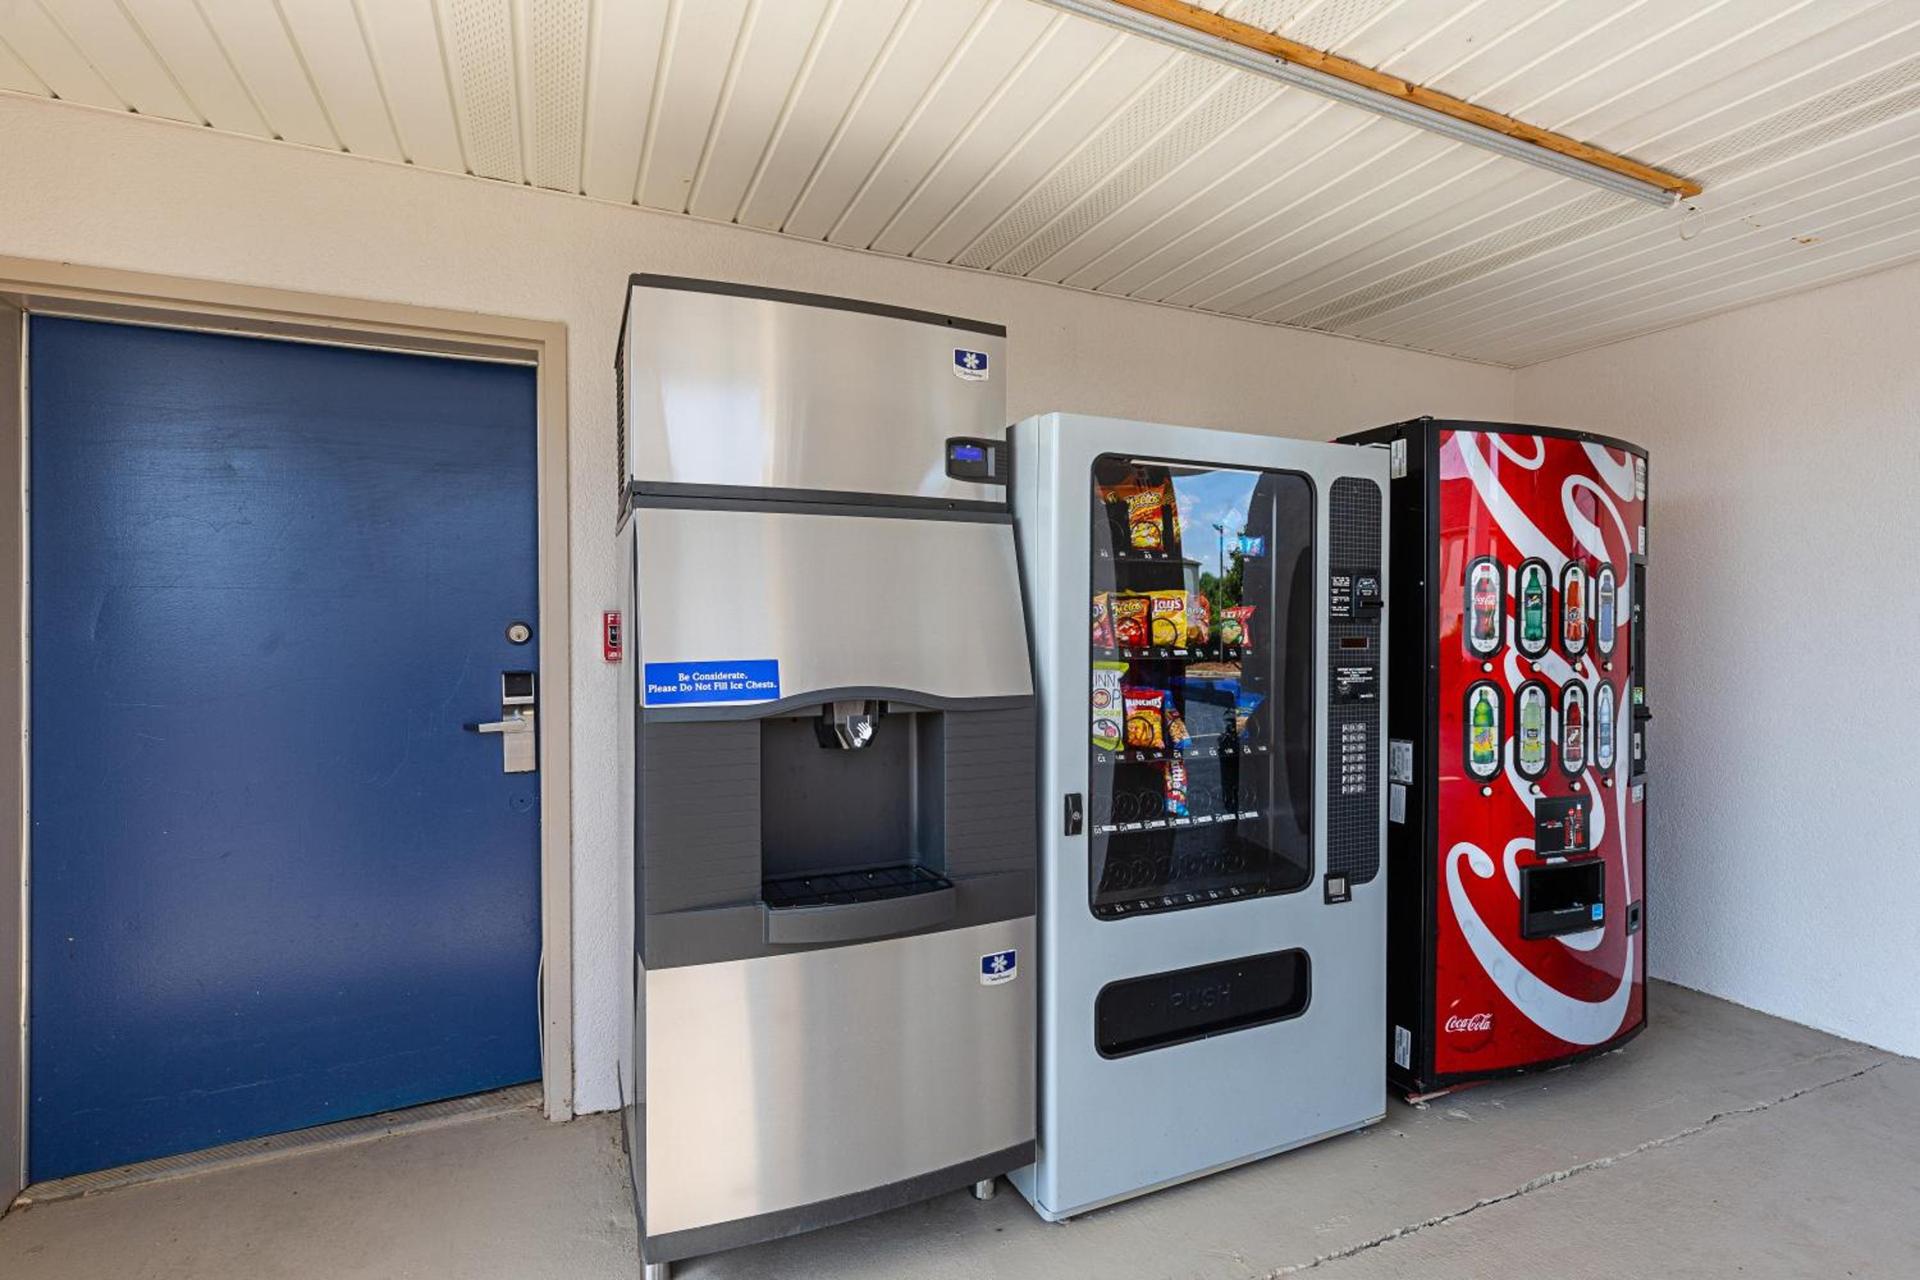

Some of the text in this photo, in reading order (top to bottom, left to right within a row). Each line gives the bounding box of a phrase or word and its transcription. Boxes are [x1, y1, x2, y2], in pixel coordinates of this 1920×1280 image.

[678, 671, 748, 682] Be Considerate.
[648, 680, 777, 693] Please Do Not Fill Ice Chests.
[1444, 1013, 1493, 1033] Coca-Cola
